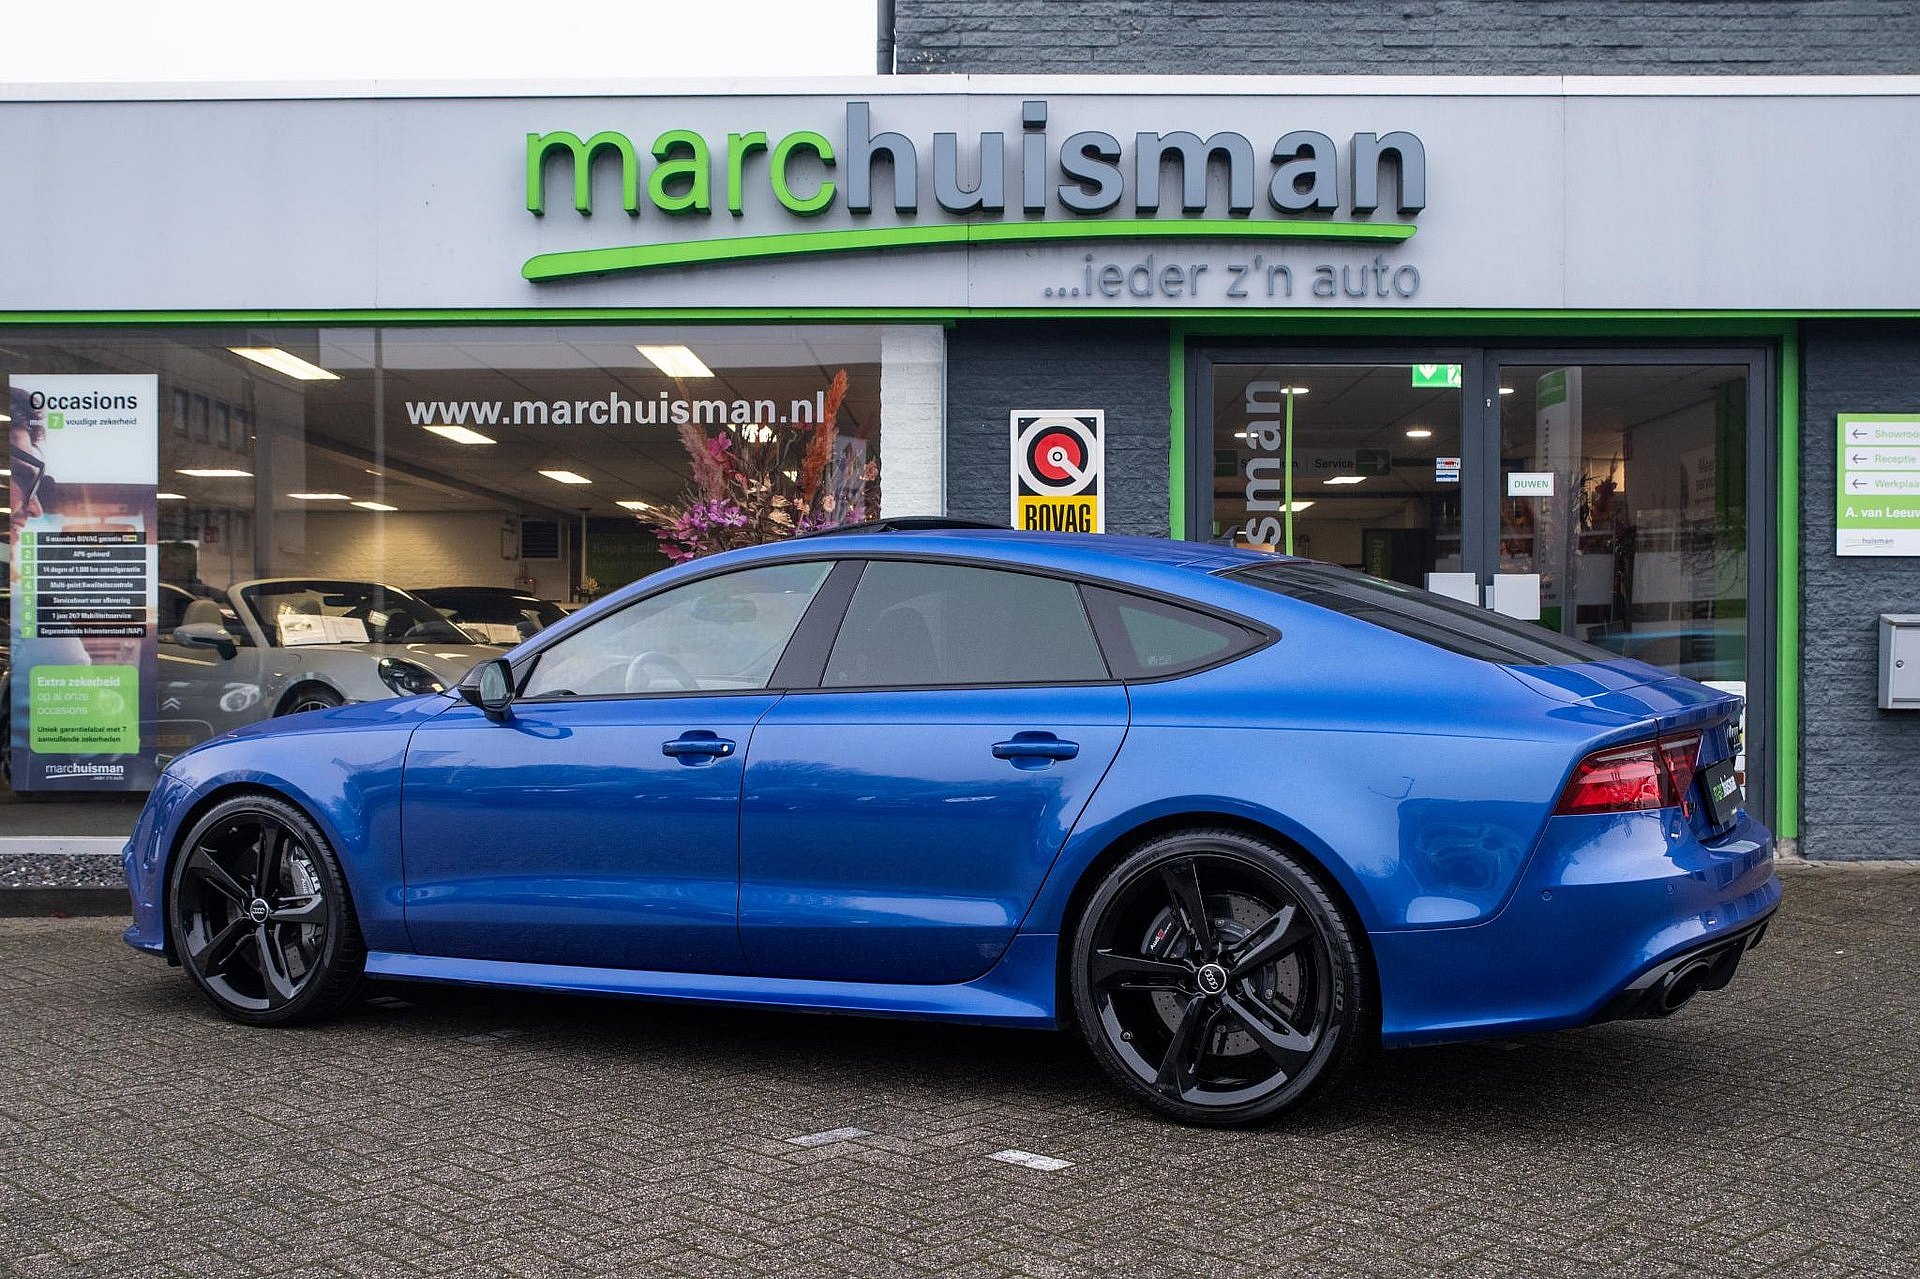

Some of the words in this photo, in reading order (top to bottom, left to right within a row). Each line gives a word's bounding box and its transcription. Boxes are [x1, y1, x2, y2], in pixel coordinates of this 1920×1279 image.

[526, 101, 1426, 217] marchuisman
[1045, 254, 1208, 298] ...ieder
[1227, 254, 1293, 298] z'n
[1312, 254, 1421, 298] auto
[30, 391, 138, 410] Occasions
[405, 391, 825, 425] www.marchuisman.nl
[66, 417, 98, 426] voudige
[99, 417, 137, 426] zekerheid
[1314, 458, 1354, 469] Service
[1875, 454, 1917, 465] Receptie
[1514, 479, 1549, 488] DUWEN
[1845, 506, 1858, 518] A.
[1861, 509, 1882, 518] van
[1025, 504, 1091, 533] BOVAG
[37, 676, 67, 687] Extra
[68, 676, 121, 687] zekerheid
[37, 705, 88, 715] occasions
[59, 726, 105, 735] garantielabel
[45, 762, 124, 773] marchuisman
